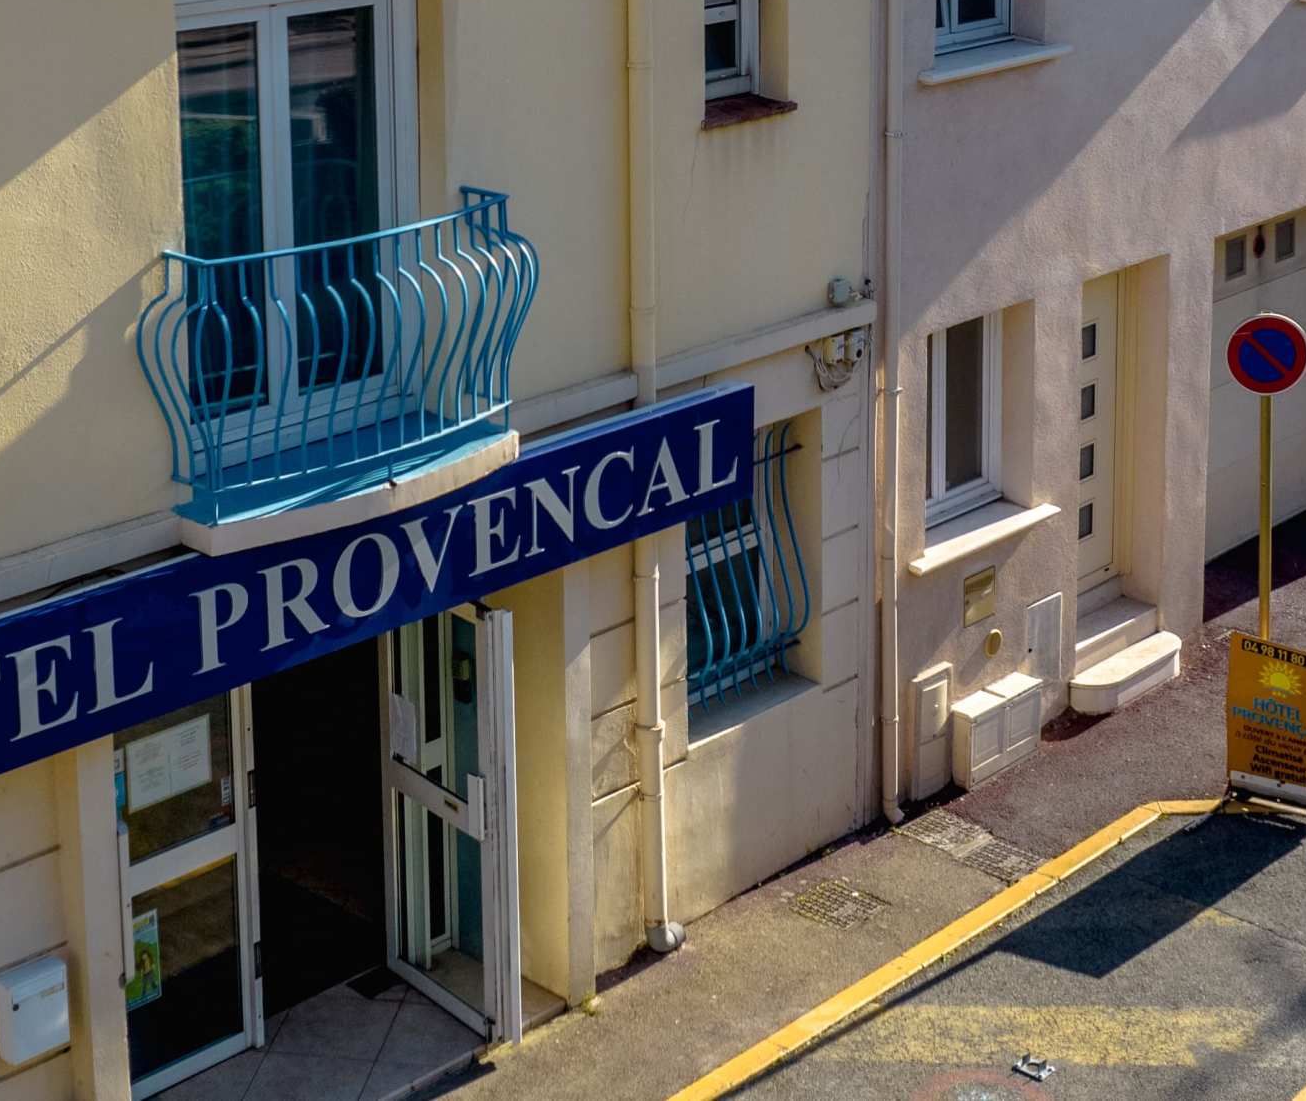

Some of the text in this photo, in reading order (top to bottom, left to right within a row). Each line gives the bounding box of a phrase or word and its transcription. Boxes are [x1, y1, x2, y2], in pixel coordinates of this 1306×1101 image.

[188, 419, 738, 675] PROVENCAL
[1244, 640, 1258, 653] 04
[1260, 645, 1275, 657] 98
[1277, 649, 1288, 661] 11
[1291, 653, 1305, 666] 80
[1253, 754, 1306, 773] Ascenseur
